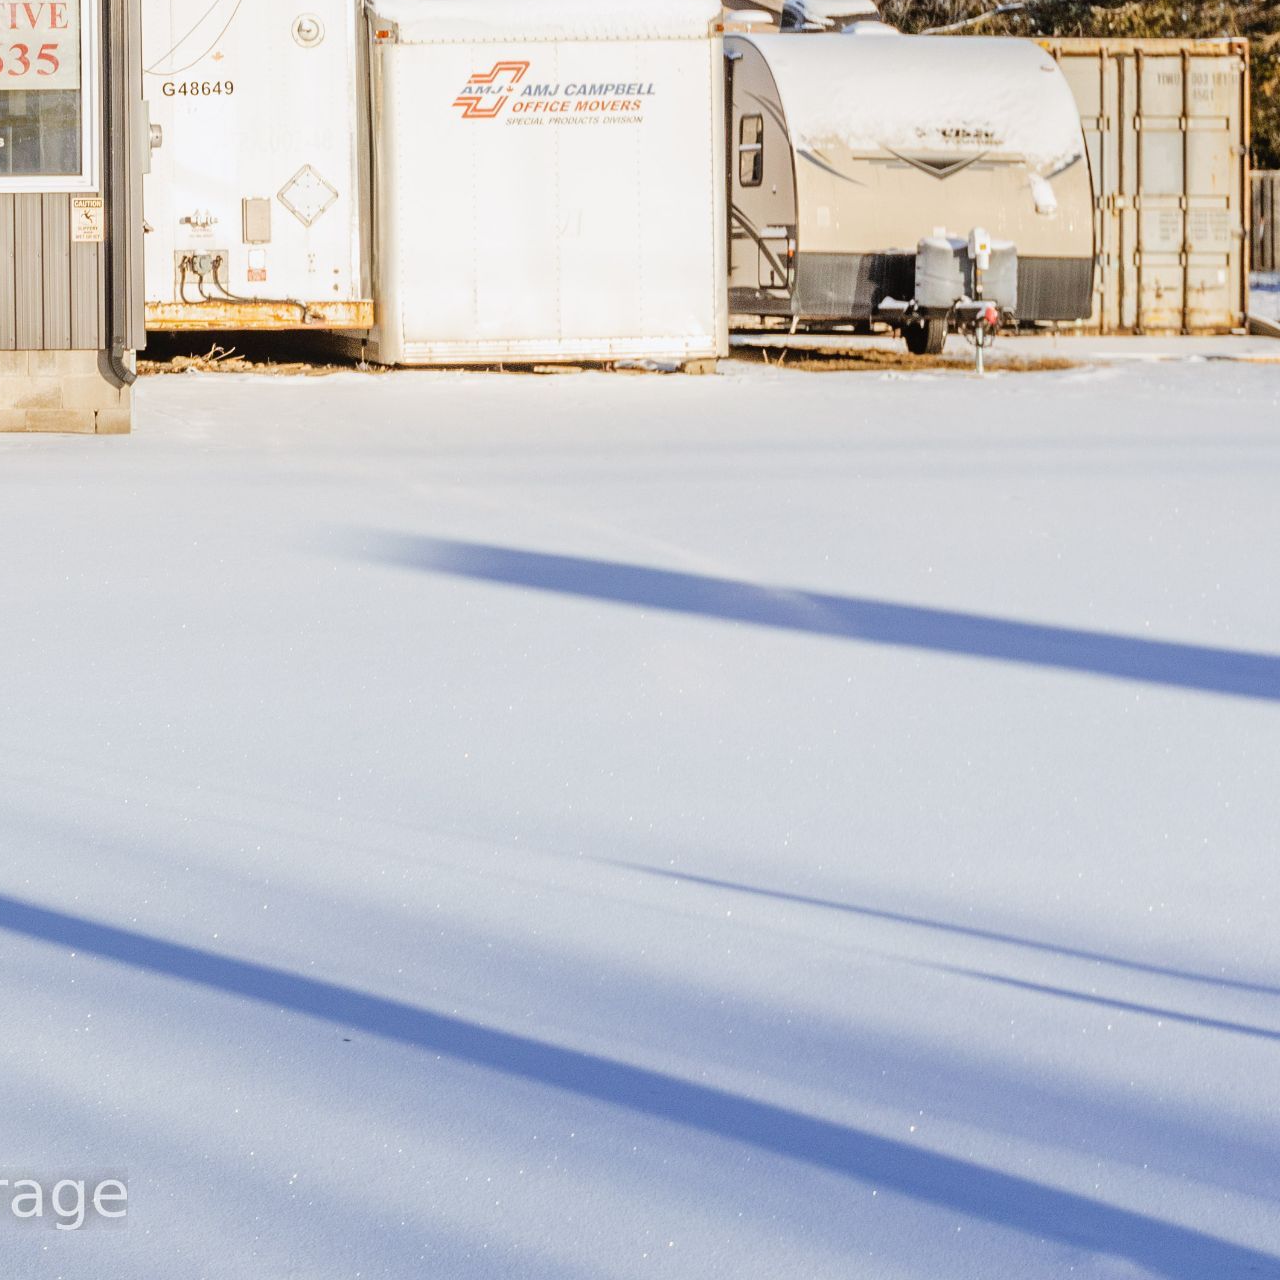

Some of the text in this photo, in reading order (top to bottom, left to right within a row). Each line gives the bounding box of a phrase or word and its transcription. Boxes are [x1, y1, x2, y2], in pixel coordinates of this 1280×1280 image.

[162, 80, 234, 97] G48649
[460, 86, 503, 95] AMJ
[520, 83, 656, 97] AMJ CAMPBELL
[512, 99, 642, 113] OFFICE MOVERS
[505, 115, 644, 126] SPECIAL PRODUCTS DIVISION
[74, 200, 101, 208] CAUTION
